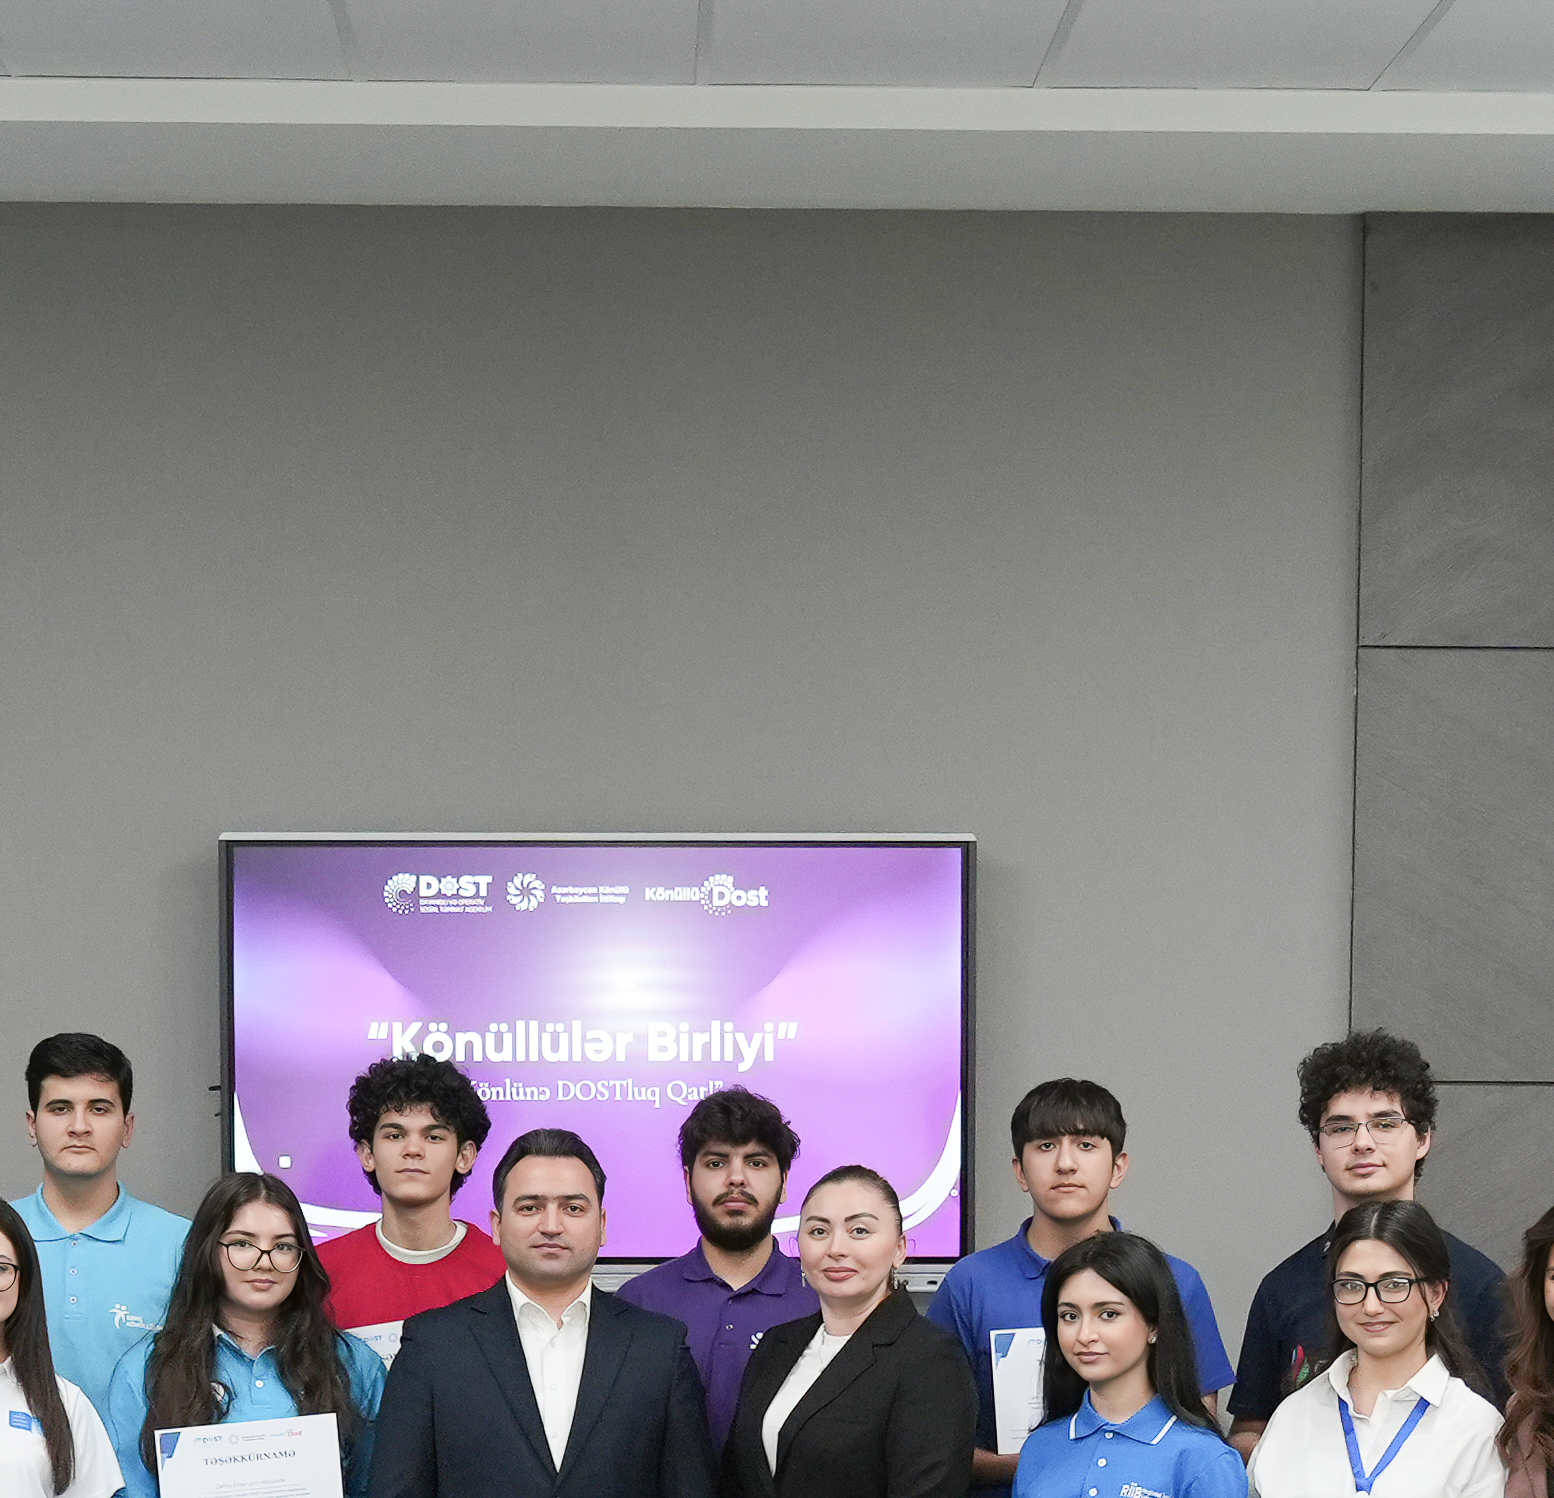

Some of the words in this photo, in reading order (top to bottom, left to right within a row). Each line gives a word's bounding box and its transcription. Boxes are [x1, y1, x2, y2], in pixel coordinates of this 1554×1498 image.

[418, 874, 493, 897] DOST
[712, 885, 769, 907] Dost
[471, 1078, 551, 1102] önlünə
[556, 1079, 661, 1109] DOSTluq
